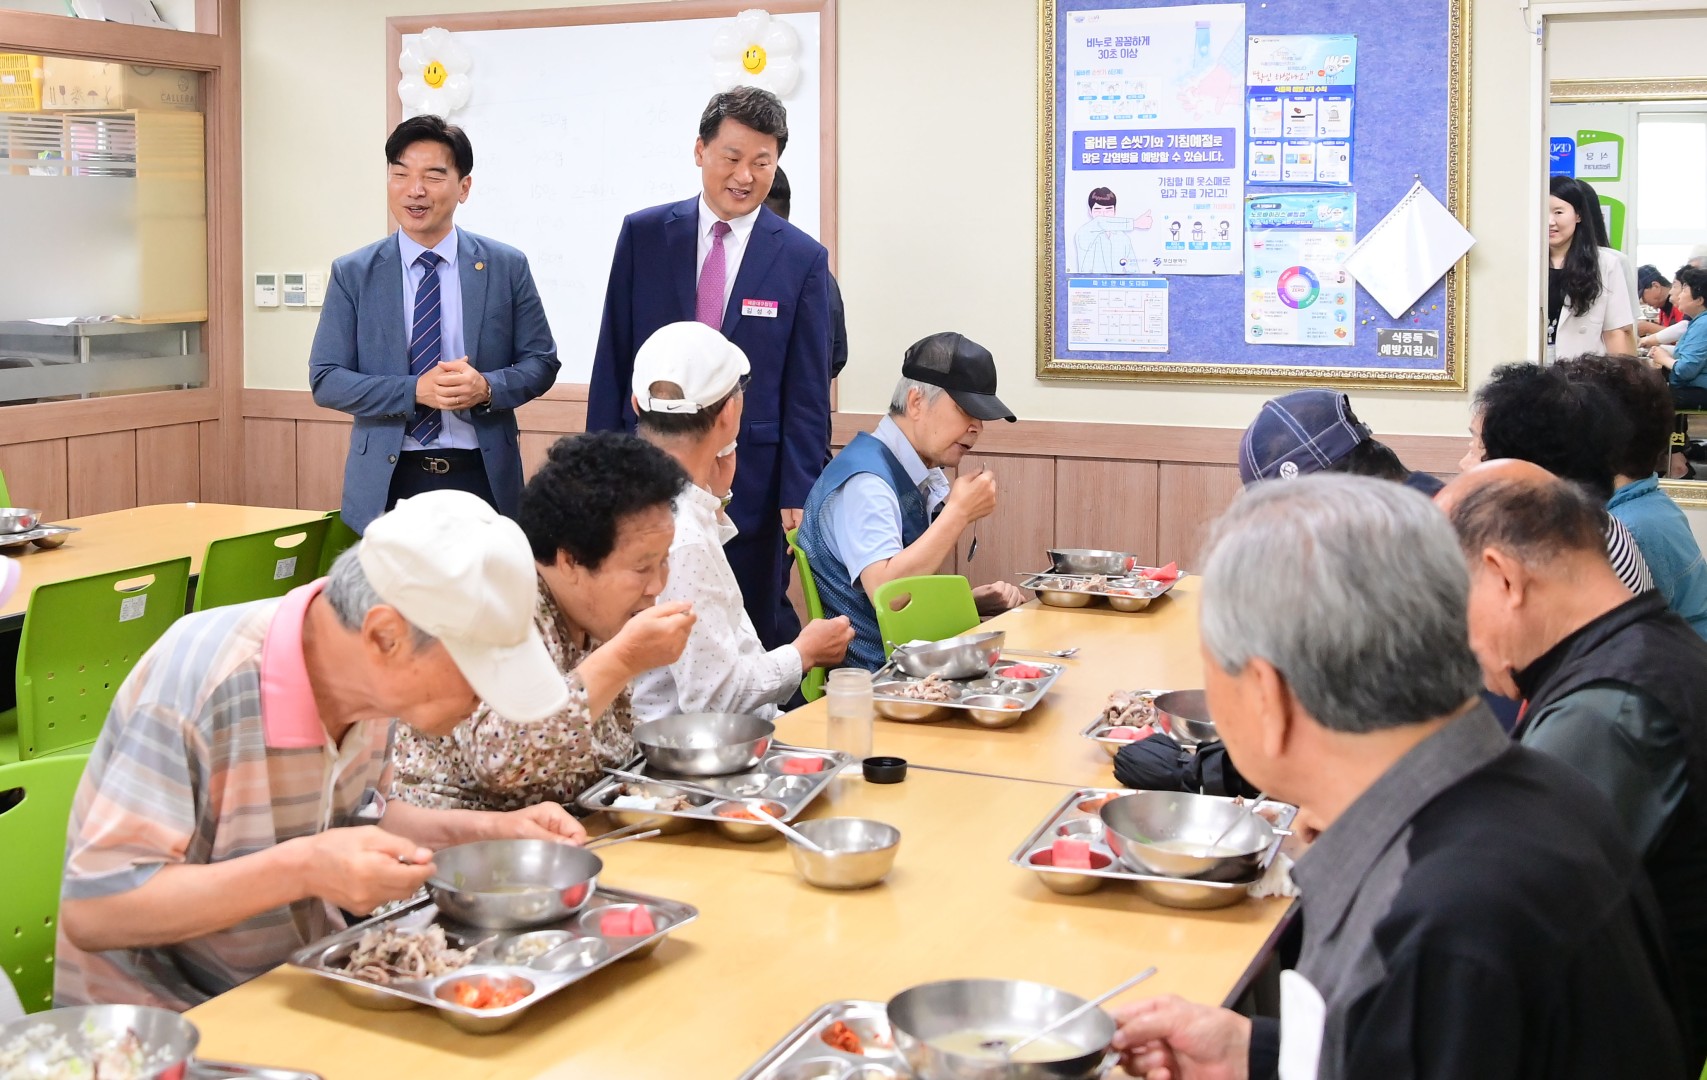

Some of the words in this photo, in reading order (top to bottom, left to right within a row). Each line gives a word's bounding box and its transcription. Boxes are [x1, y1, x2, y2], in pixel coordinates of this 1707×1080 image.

[1086, 36, 1113, 48] 비누로
[1115, 35, 1151, 47] 꼼꼼하게
[1097, 49, 1118, 59] 30초
[1120, 48, 1138, 58] 이상
[1084, 136, 1118, 150] 올바른
[1121, 135, 1163, 149] 손씻기와
[1167, 134, 1223, 148] 기침예절로
[1082, 153, 1100, 164] 많은
[1102, 152, 1139, 164] 감염병을
[1141, 151, 1170, 163] 예방할
[1171, 151, 1181, 162] 수
[1183, 150, 1225, 162] 있습니다.
[1251, 170, 1257, 178] 4
[1285, 170, 1291, 178] 5
[1319, 170, 1325, 178] 6
[1158, 177, 1183, 187] 기침할
[1185, 177, 1195, 187] 때
[1196, 176, 1231, 187] 옷소매로
[1160, 189, 1178, 199] 입과
[1180, 189, 1197, 199] 코를
[1199, 188, 1228, 198] 가리고!
[1391, 332, 1424, 344] 식중독
[1380, 344, 1434, 357] 예방지침서
